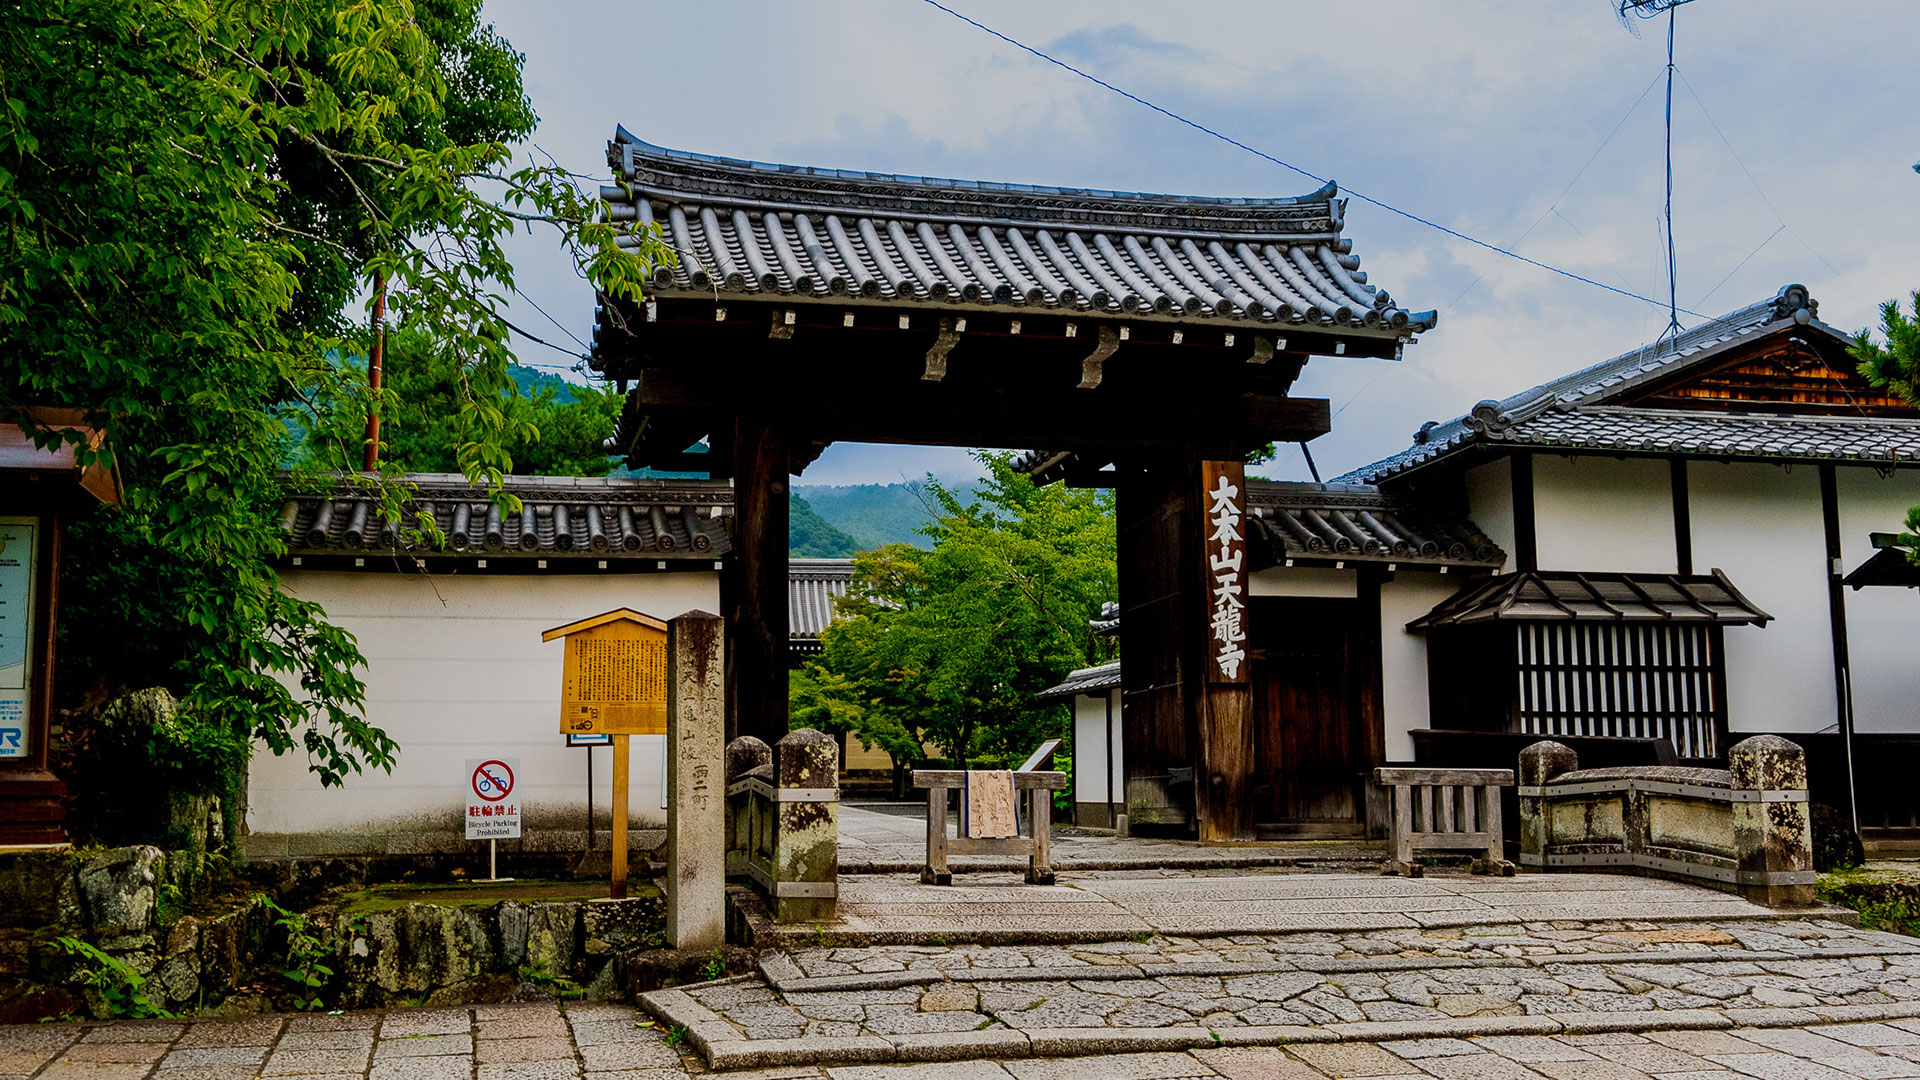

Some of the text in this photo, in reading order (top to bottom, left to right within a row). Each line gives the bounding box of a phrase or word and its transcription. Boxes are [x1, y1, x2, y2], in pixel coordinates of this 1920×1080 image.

[1208, 475, 1245, 679] 大本山天龍寺
[692, 764, 709, 811] 西二町
[468, 821, 491, 829] Bicycle
[469, 804, 517, 817] 駐輪禁止
